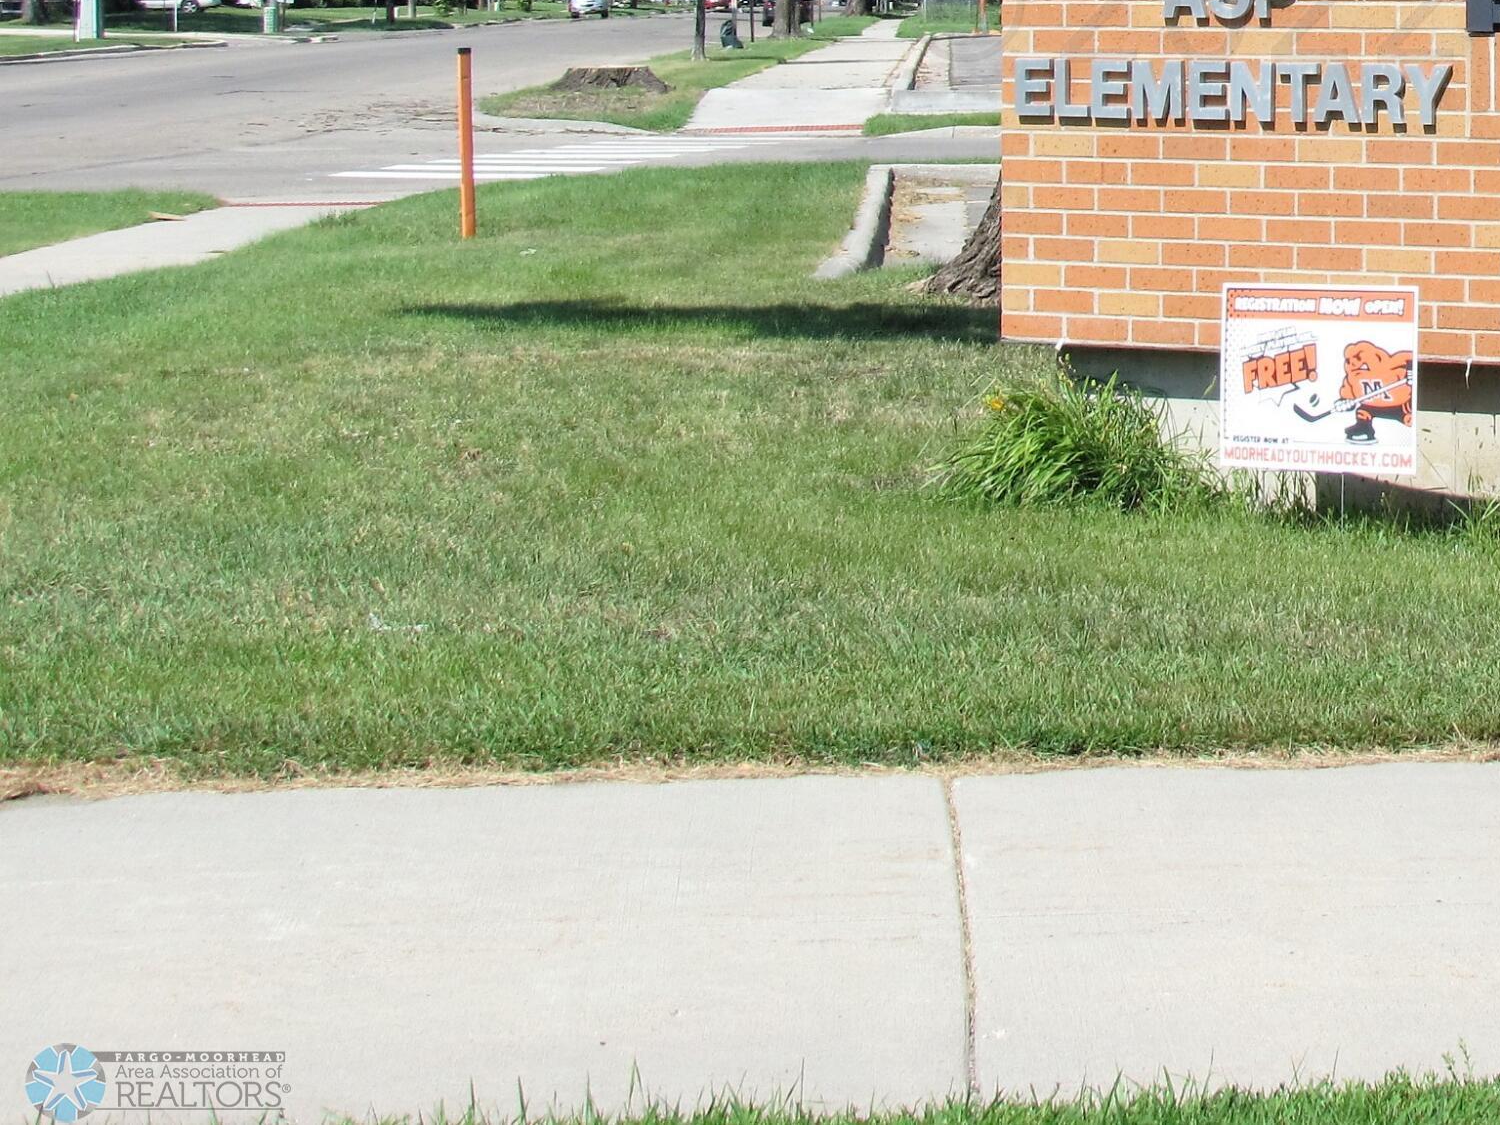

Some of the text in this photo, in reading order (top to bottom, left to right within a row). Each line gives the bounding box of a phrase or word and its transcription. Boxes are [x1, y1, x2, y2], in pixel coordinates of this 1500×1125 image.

[1013, 57, 1454, 128] ELEMENTARY
[1242, 342, 1318, 394] FREE!
[1224, 446, 1413, 468] MOORHEADYOUTHHOCKEY.COM
[1232, 435, 1261, 444] REGISTER
